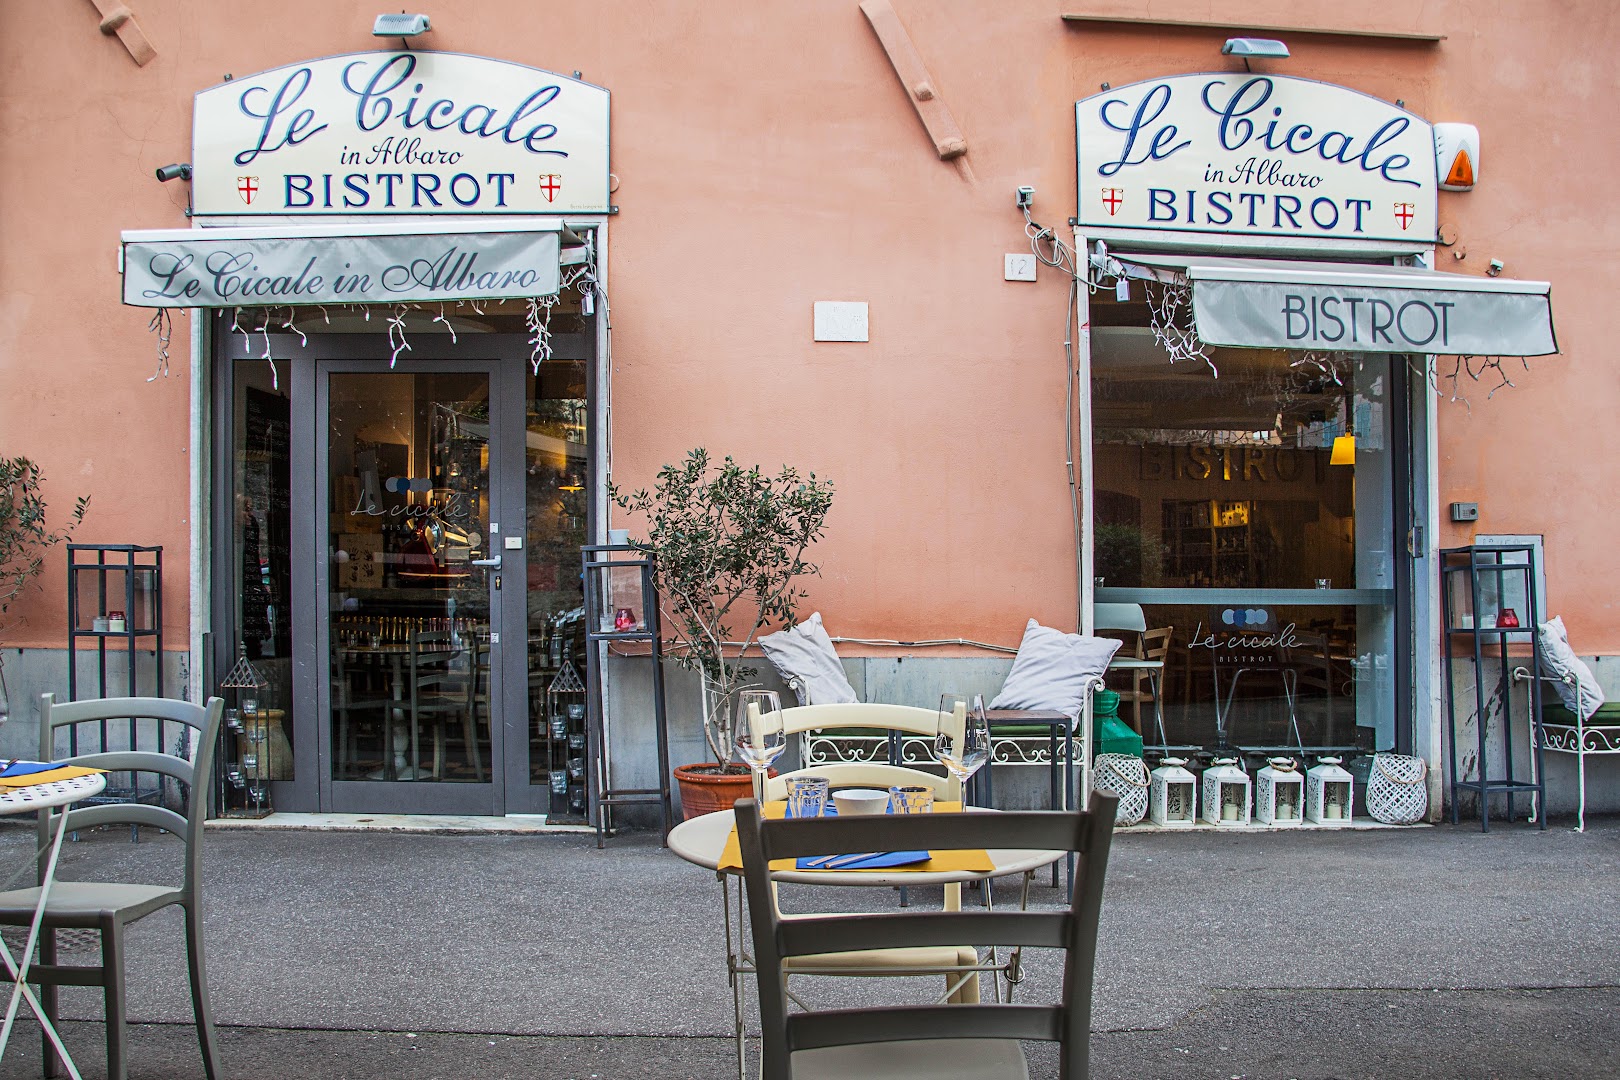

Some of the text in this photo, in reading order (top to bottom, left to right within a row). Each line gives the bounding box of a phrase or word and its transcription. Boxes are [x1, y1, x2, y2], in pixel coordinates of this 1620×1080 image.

[234, 54, 569, 166] Le Cicale
[1097, 78, 1421, 188] Le Cicale
[340, 136, 464, 165] in Albaro
[1204, 157, 1324, 188] in Albaro
[283, 172, 515, 208] BISTROT
[1147, 188, 1371, 233] BISTROT
[143, 246, 541, 301] Le Cicale in Albaro
[1282, 294, 1455, 346] BISTROT
[350, 488, 387, 516] Le
[381, 523, 436, 531] BISTRO
[1187, 621, 1303, 649] Le cicale
[1219, 655, 1273, 663] BISTROT
